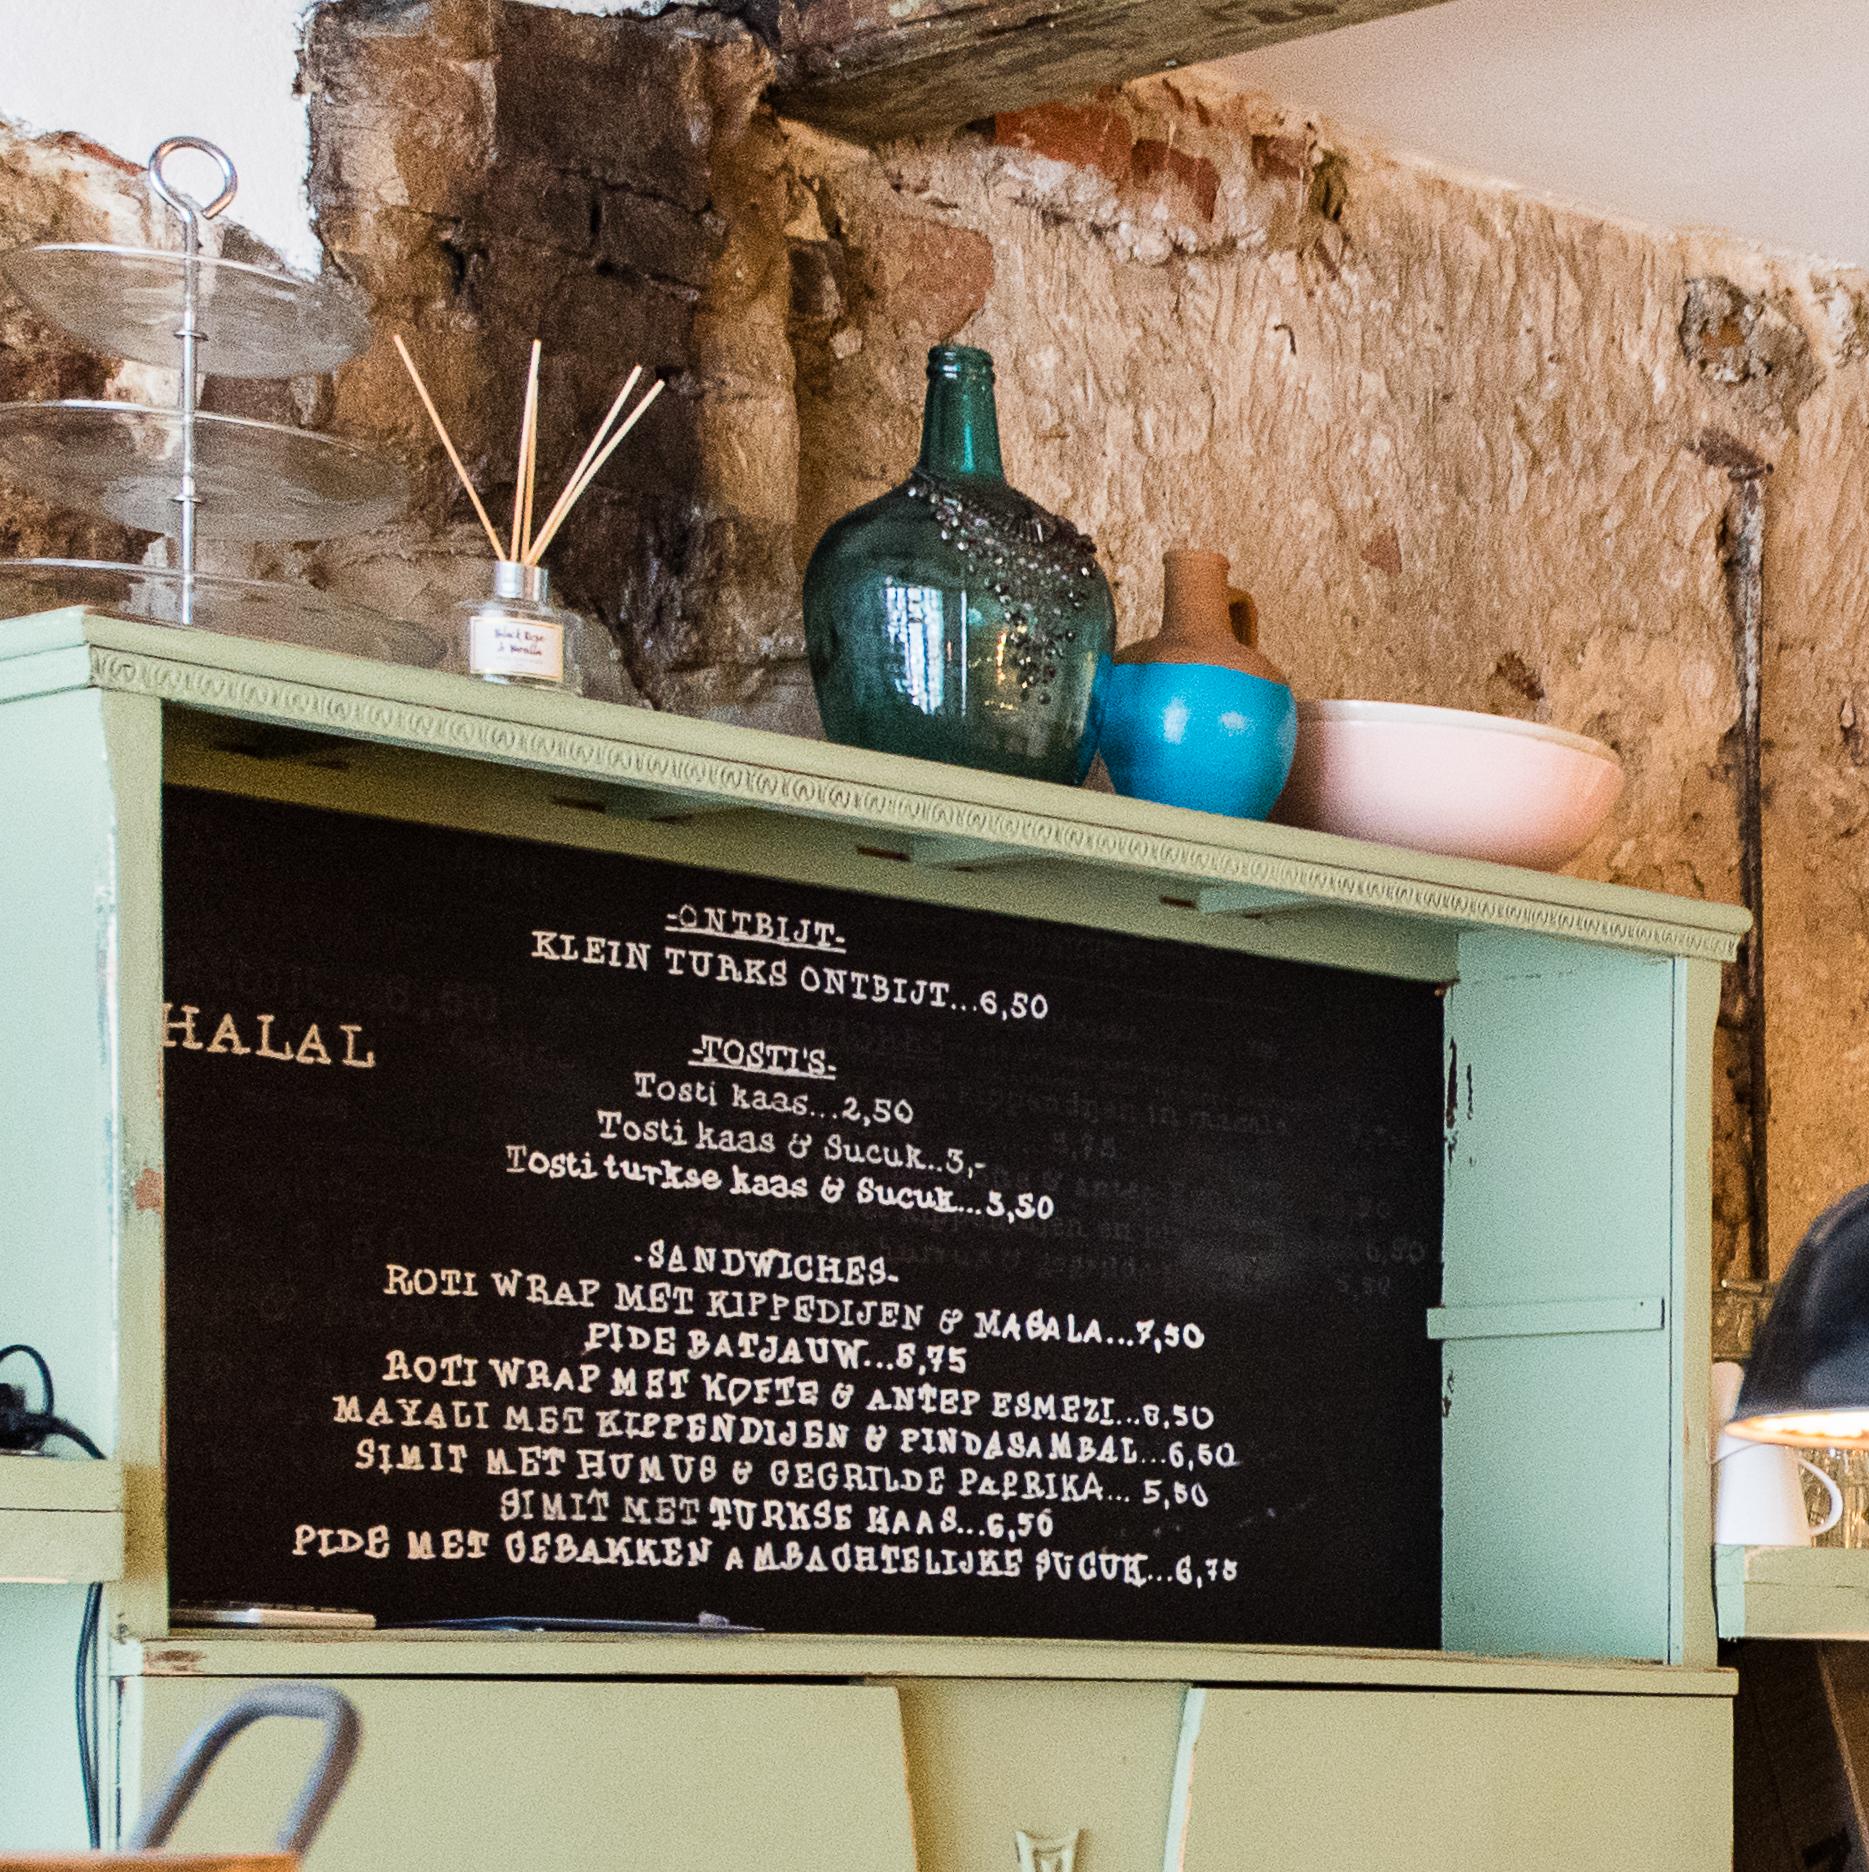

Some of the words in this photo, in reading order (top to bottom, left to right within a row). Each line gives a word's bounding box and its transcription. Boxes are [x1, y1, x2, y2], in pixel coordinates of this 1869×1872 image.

[532, 931, 650, 970] KLEIN
[665, 947, 786, 986] TURKS
[162, 1002, 376, 1068] HALAL
[634, 1072, 716, 1106] Tosti
[597, 1110, 687, 1145] Tosti
[696, 1121, 775, 1153] kaas
[788, 1134, 812, 1158] &
[506, 1145, 597, 1179] Tosti
[603, 1154, 722, 1190] turkse
[730, 1165, 808, 1198] kaas
[821, 1176, 845, 1203] &
[384, 1264, 478, 1296] ROTI
[491, 1269, 600, 1307] WRAP
[615, 1282, 693, 1314] MET
[706, 1290, 923, 1330] KIPPEDIJEN
[939, 1309, 963, 1334] &
[584, 1322, 675, 1356] PIDE
[382, 1350, 478, 1386] ROTI
[489, 1357, 600, 1393] WRAP
[610, 1368, 689, 1399] MET
[701, 1373, 818, 1406] KOFTE
[832, 1382, 854, 1409] &
[866, 1383, 980, 1415] ANTEP
[333, 1395, 488, 1429] MAYALI
[504, 1406, 583, 1434] MET
[596, 1409, 849, 1448] KIPPENDIJEN
[865, 1425, 887, 1452] &
[355, 1439, 467, 1474] SIMIT
[487, 1445, 565, 1476] MET
[577, 1449, 716, 1483] HUMUS
[732, 1461, 752, 1485] &
[501, 1488, 609, 1521] SIMIT
[622, 1496, 699, 1525] MET
[709, 1497, 852, 1530] TURKSE
[293, 1525, 389, 1558] PIDE
[408, 1529, 489, 1559] MET
[505, 1530, 712, 1566] GEBAKKEN
